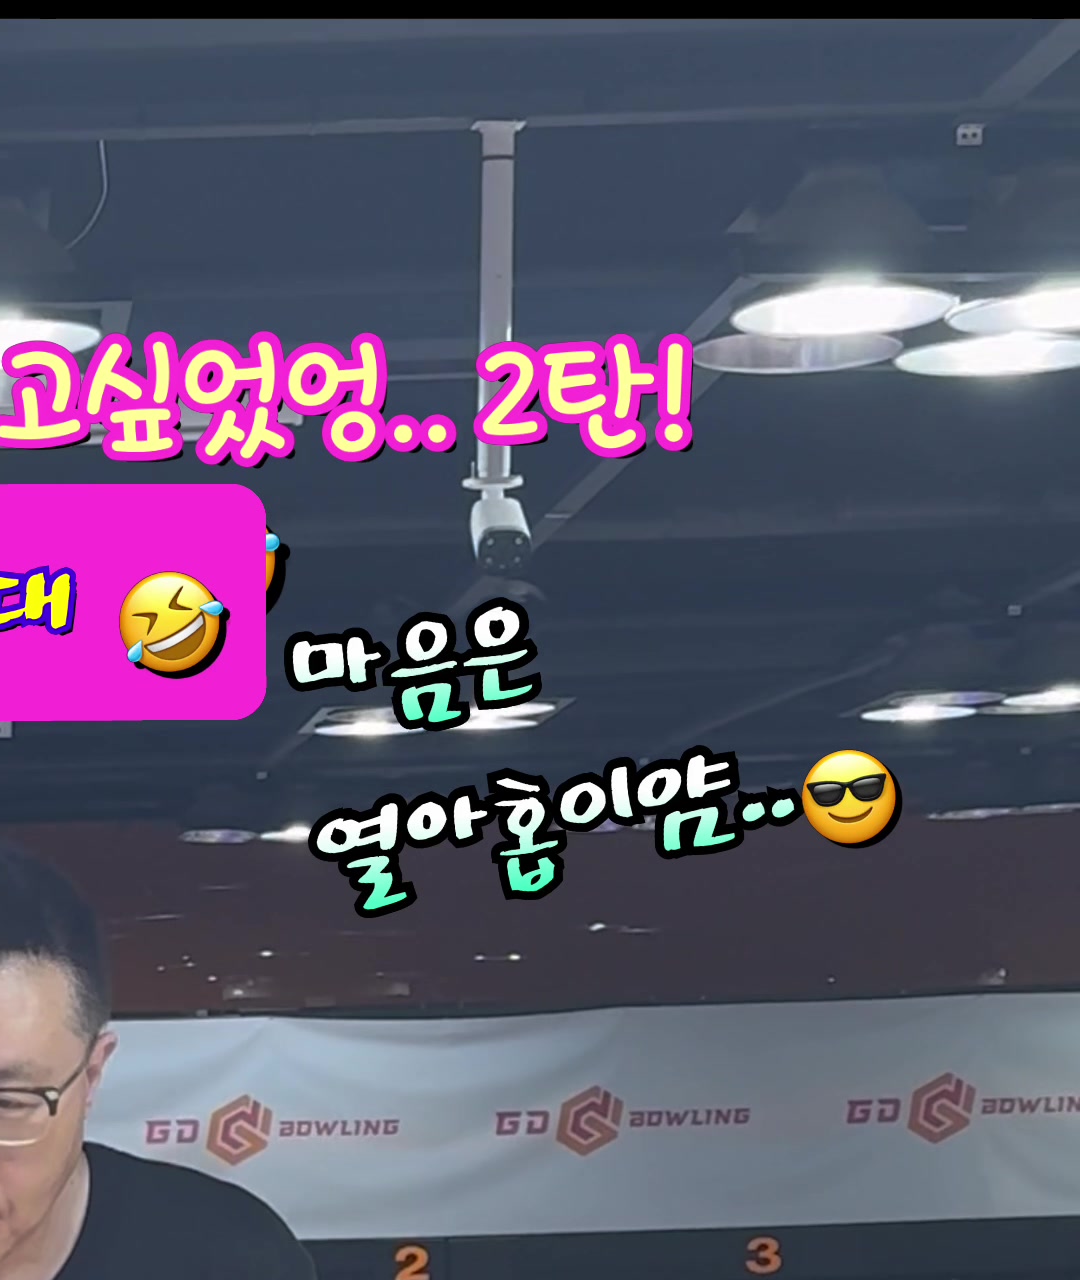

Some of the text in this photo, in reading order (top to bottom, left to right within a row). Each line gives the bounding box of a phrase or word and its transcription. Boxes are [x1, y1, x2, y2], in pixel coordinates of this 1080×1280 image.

[495, 1108, 751, 1136] GD BOWLING
[846, 1096, 1080, 1125] GD BOWLIN
[145, 1119, 400, 1144] GD BOWLING
[744, 1235, 783, 1275] 3
